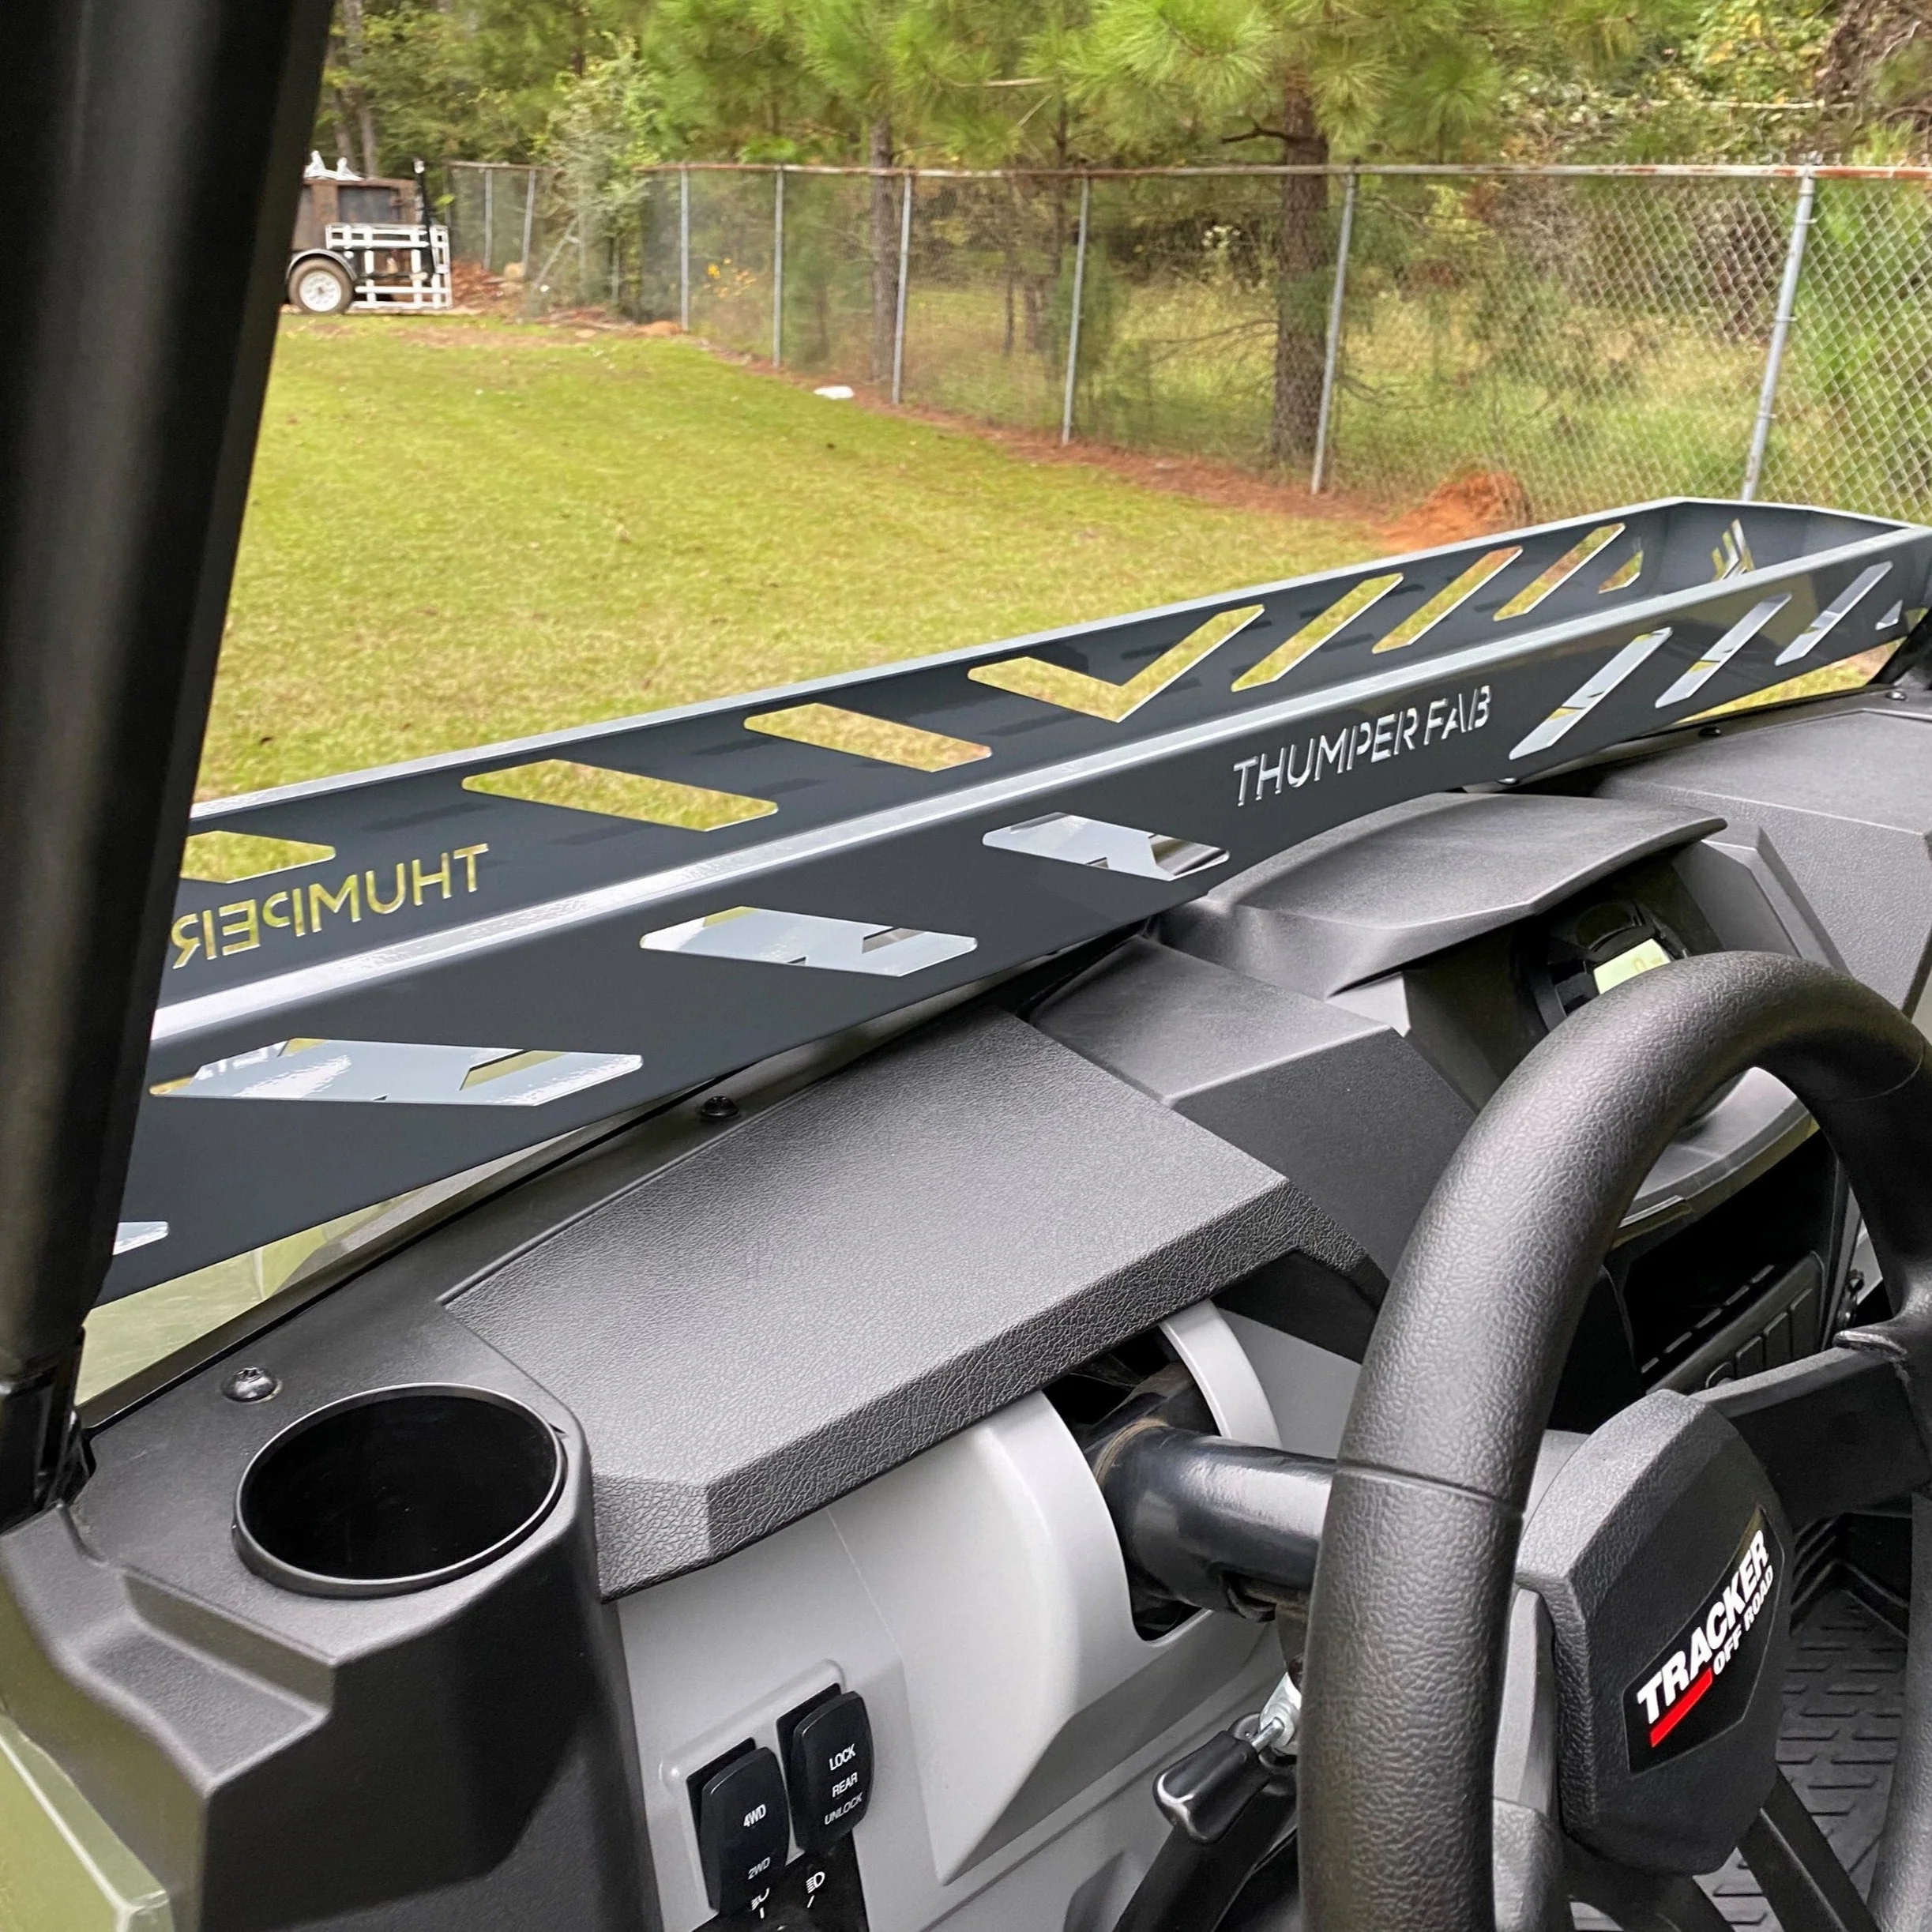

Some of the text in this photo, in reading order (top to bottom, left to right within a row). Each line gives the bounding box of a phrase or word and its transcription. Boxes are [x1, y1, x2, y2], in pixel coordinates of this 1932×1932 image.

[1637, 1530, 1769, 1724] TRACKER
[1713, 1565, 1773, 1675] OFF ROAD
[829, 1743, 856, 1771] LOCK
[832, 1772, 858, 1798] REAR
[743, 1803, 767, 1827] 4WD
[825, 1791, 863, 1825] UNLOCK
[747, 1856, 771, 1880] 2WD
